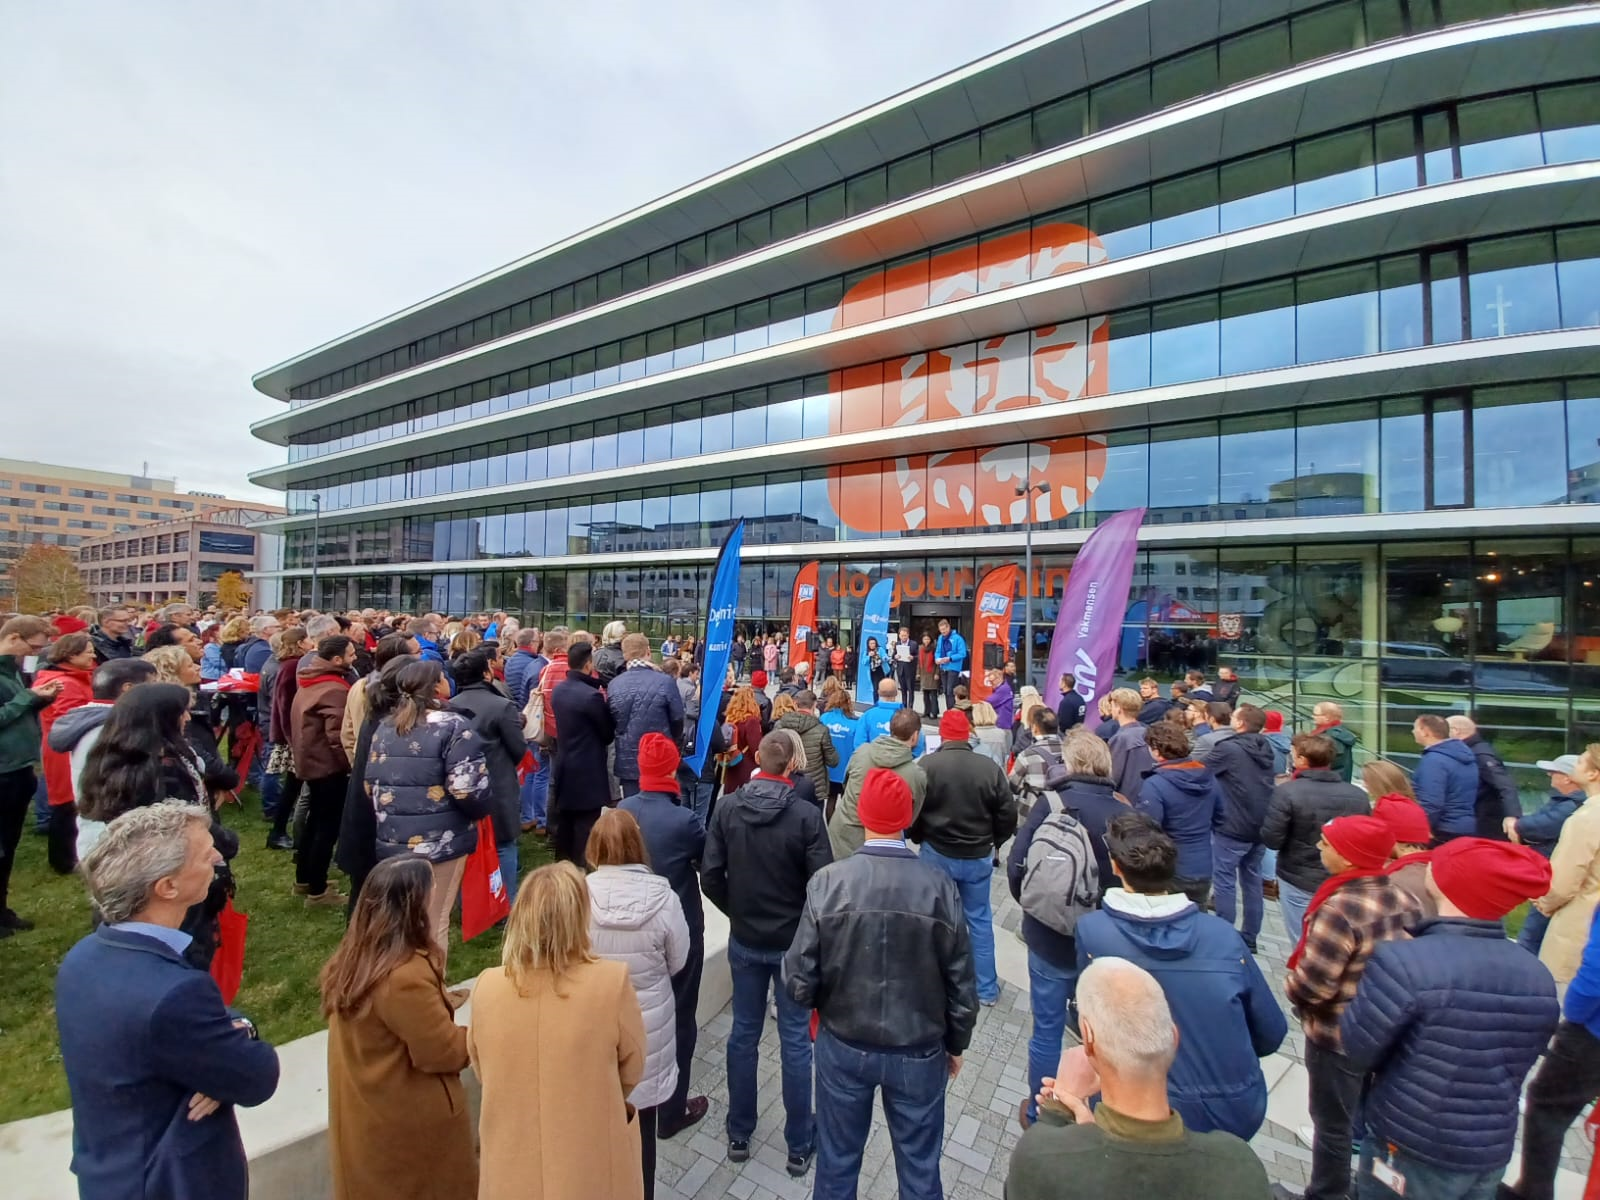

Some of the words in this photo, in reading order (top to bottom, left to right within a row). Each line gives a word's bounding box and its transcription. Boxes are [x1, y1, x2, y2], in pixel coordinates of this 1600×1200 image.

[827, 564, 870, 598] do
[981, 593, 1008, 614] FNV
[1077, 581, 1098, 638] Vakmensen
